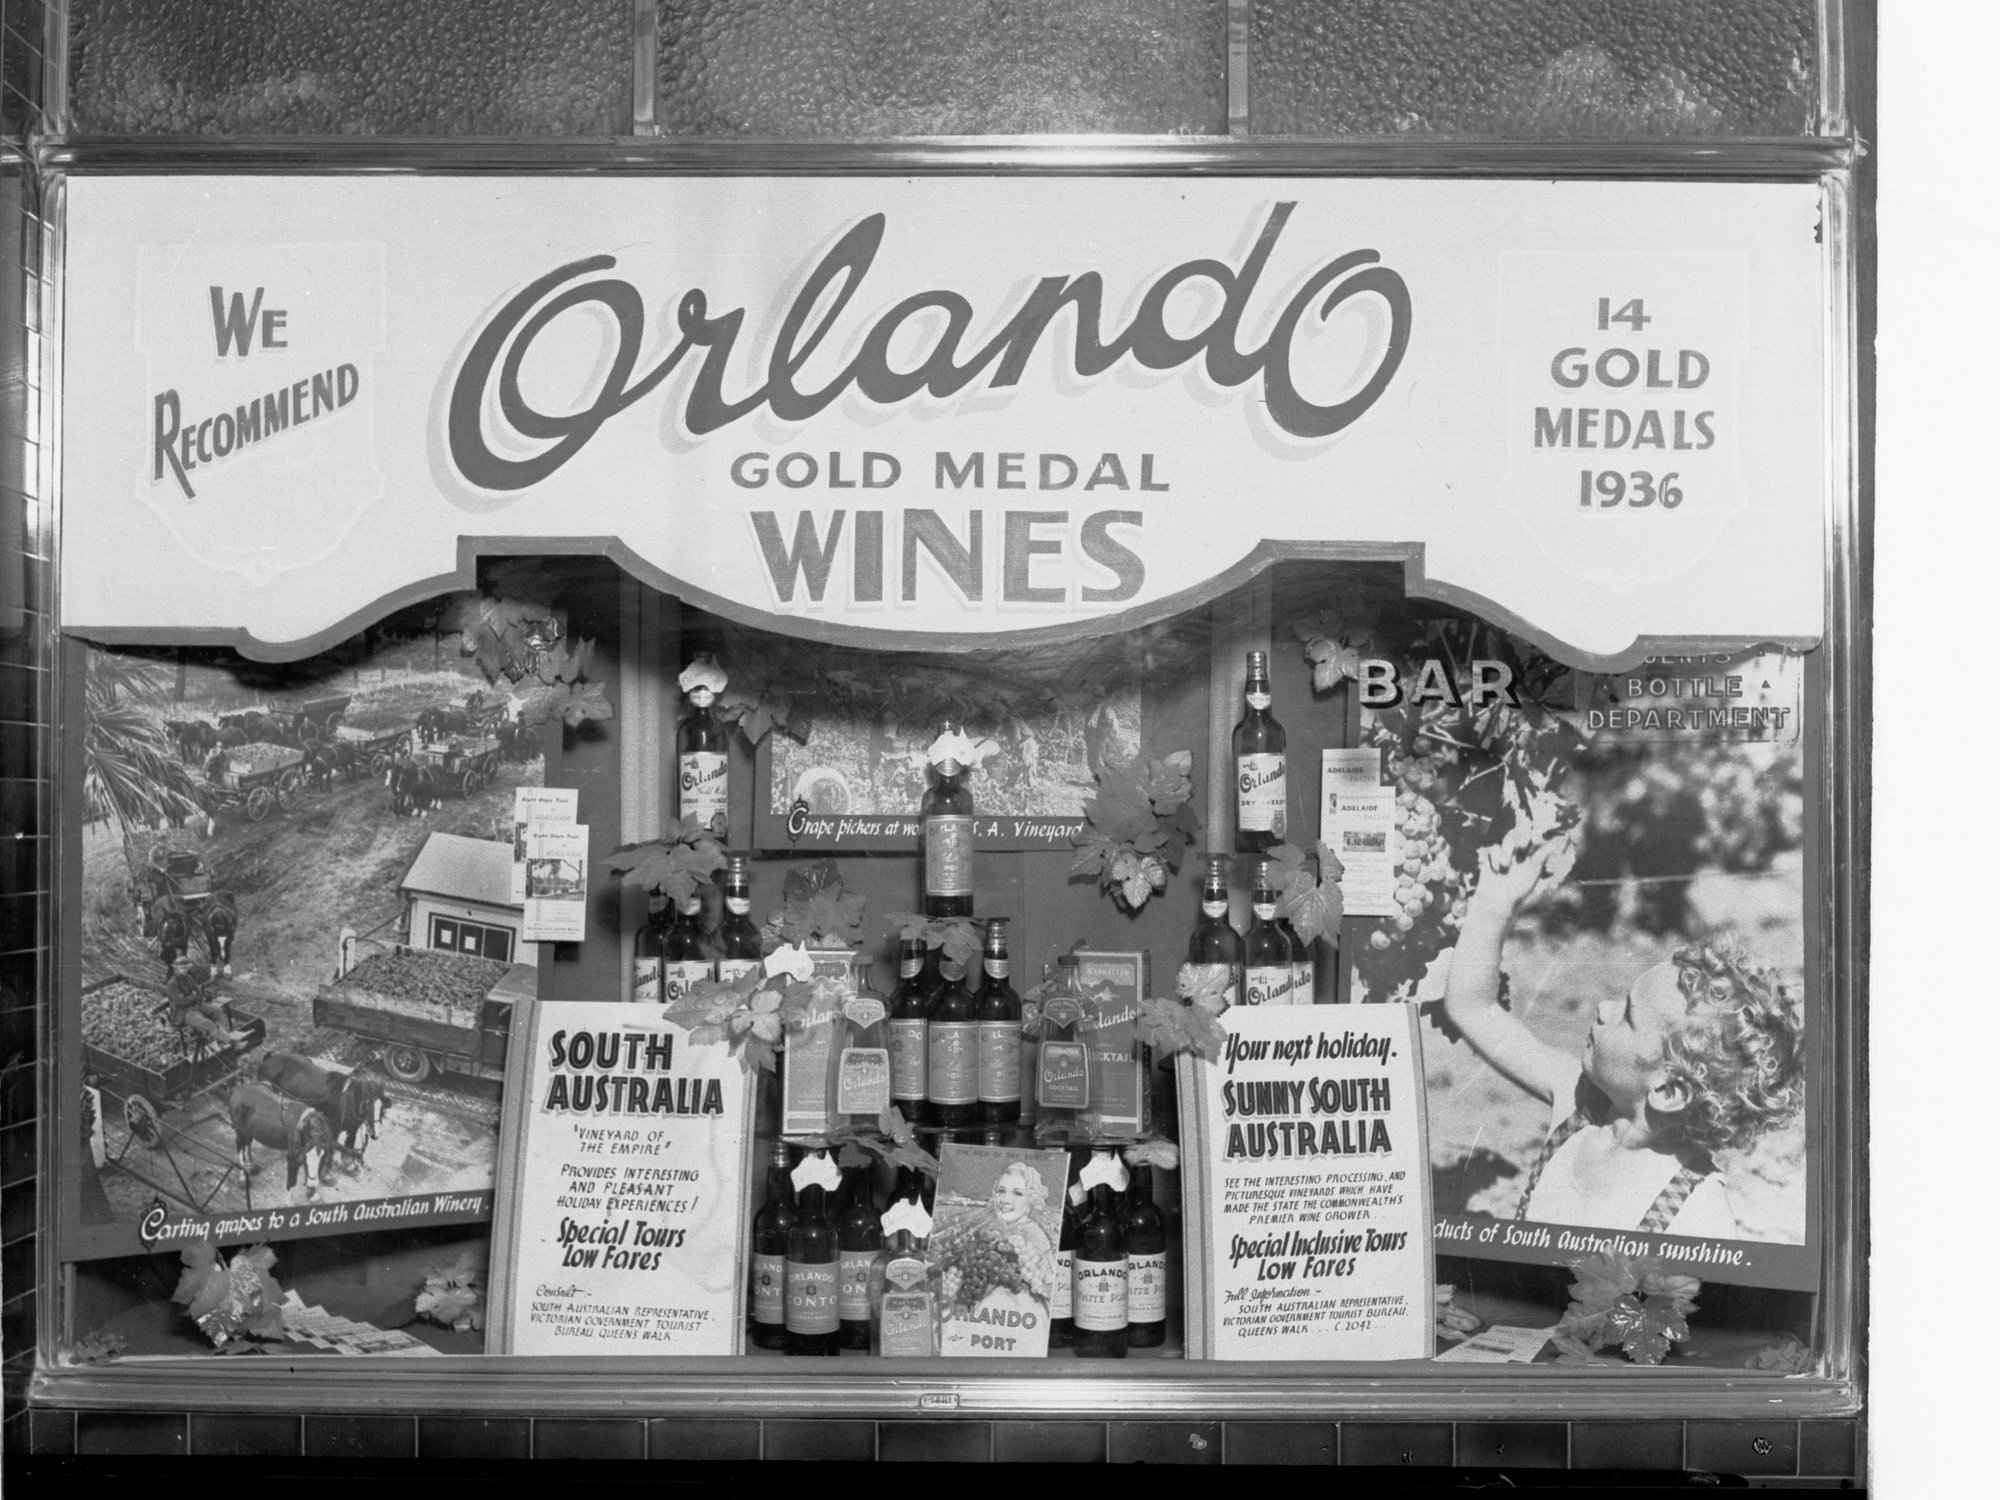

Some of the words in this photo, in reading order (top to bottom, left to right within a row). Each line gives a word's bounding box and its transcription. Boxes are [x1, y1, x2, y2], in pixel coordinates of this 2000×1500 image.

[1597, 297, 1652, 332] 14
[1551, 348, 1710, 389] GOLD
[1533, 407, 1716, 450] MEDALS
[730, 451, 902, 489] GOLD
[935, 452, 1170, 492] MEDAL
[1579, 470, 1684, 509] 1936
[749, 508, 1146, 604] WINES
[1358, 658, 1522, 710] BAR
[1627, 676, 1743, 697] BOTTLE
[1588, 707, 1790, 730] DEPARTMENT
[788, 807, 834, 841] Grape
[836, 820, 880, 842] pickers
[885, 822, 899, 836] at
[902, 823, 918, 836] wo
[1013, 821, 1084, 842] Vineyard
[1095, 1005, 1137, 1029] lando
[551, 1029, 674, 1071] SOUTH
[1225, 1033, 1270, 1074] Your
[1272, 1038, 1313, 1066] next
[1044, 1067, 1084, 1082] Orlando
[545, 1074, 724, 1116] AUSTRALIA
[1223, 1079, 1306, 1118] SUNNY
[1310, 1077, 1391, 1114] SOUTH
[580, 1142, 604, 1153] THE
[647, 1131, 664, 1142] OF
[1226, 1118, 1392, 1159] AUSTRALIA
[561, 1163, 617, 1179] PROVIDES
[624, 1167, 700, 1182] INTERESTING
[1225, 1178, 1240, 1188] SEE
[1244, 1178, 1261, 1187] THE
[1265, 1175, 1322, 1186] INTERESTING
[1389, 1171, 1406, 1181] AND
[569, 1181, 595, 1193] AND
[604, 1182, 674, 1196] PLEASANT
[1225, 1189, 1285, 1200] PICTURESQUE
[1289, 1187, 1335, 1197] VINEYARDS
[1339, 1186, 1364, 1195] WHICH
[1369, 1184, 1393, 1194] HAVE
[556, 1195, 602, 1209] HOLIDAY
[1224, 1203, 1249, 1213] MADE
[1253, 1202, 1269, 1212] THE
[1272, 1201, 1299, 1211] STATE
[1303, 1200, 1318, 1209] THE
[141, 1207, 210, 1241] Carting
[216, 1216, 262, 1241] grapes
[268, 1212, 284, 1230] to
[290, 1214, 300, 1227] a
[306, 1205, 349, 1226] South
[354, 1199, 430, 1222] Australian
[1249, 1213, 1294, 1225] PREMIER
[1299, 1212, 1320, 1222] WINE
[557, 1217, 628, 1249] Special
[634, 1221, 686, 1248] Tours
[1434, 1219, 1473, 1241] ducts
[1480, 1226, 1498, 1243] of
[1503, 1226, 1551, 1249] South
[1558, 1231, 1649, 1256] Australian
[562, 1245, 596, 1268] Low
[602, 1247, 662, 1271] Fares
[1229, 1232, 1291, 1268] Special
[1291, 1230, 1362, 1258] Inclusive
[1363, 1228, 1408, 1251] Tours
[1078, 1269, 1127, 1280] ORLANDO
[1258, 1258, 1294, 1281] Low
[1302, 1256, 1356, 1279] Fares
[1224, 1288, 1249, 1304] Full
[1238, 1303, 1271, 1314] SOUTH
[1277, 1300, 1337, 1312] AUSTRALIAN
[531, 1302, 562, 1312] SOUTH
[567, 1303, 629, 1315] AUSTRALIAN
[941, 1297, 1037, 1329] ORLANDO
[1223, 1315, 1267, 1326] VICTORIAN
[1269, 1312, 1326, 1323] GOVERNMENT
[1329, 1310, 1362, 1319] TOURIST
[530, 1312, 581, 1324] VICTORIAN
[584, 1315, 649, 1328] GOVERNMENT
[656, 1320, 702, 1331] TOURIST
[554, 1326, 593, 1337] BUREAU
[599, 1329, 638, 1339] QUEENS
[1238, 1326, 1278, 1338] QUEENS
[970, 1334, 1016, 1351] PORT
